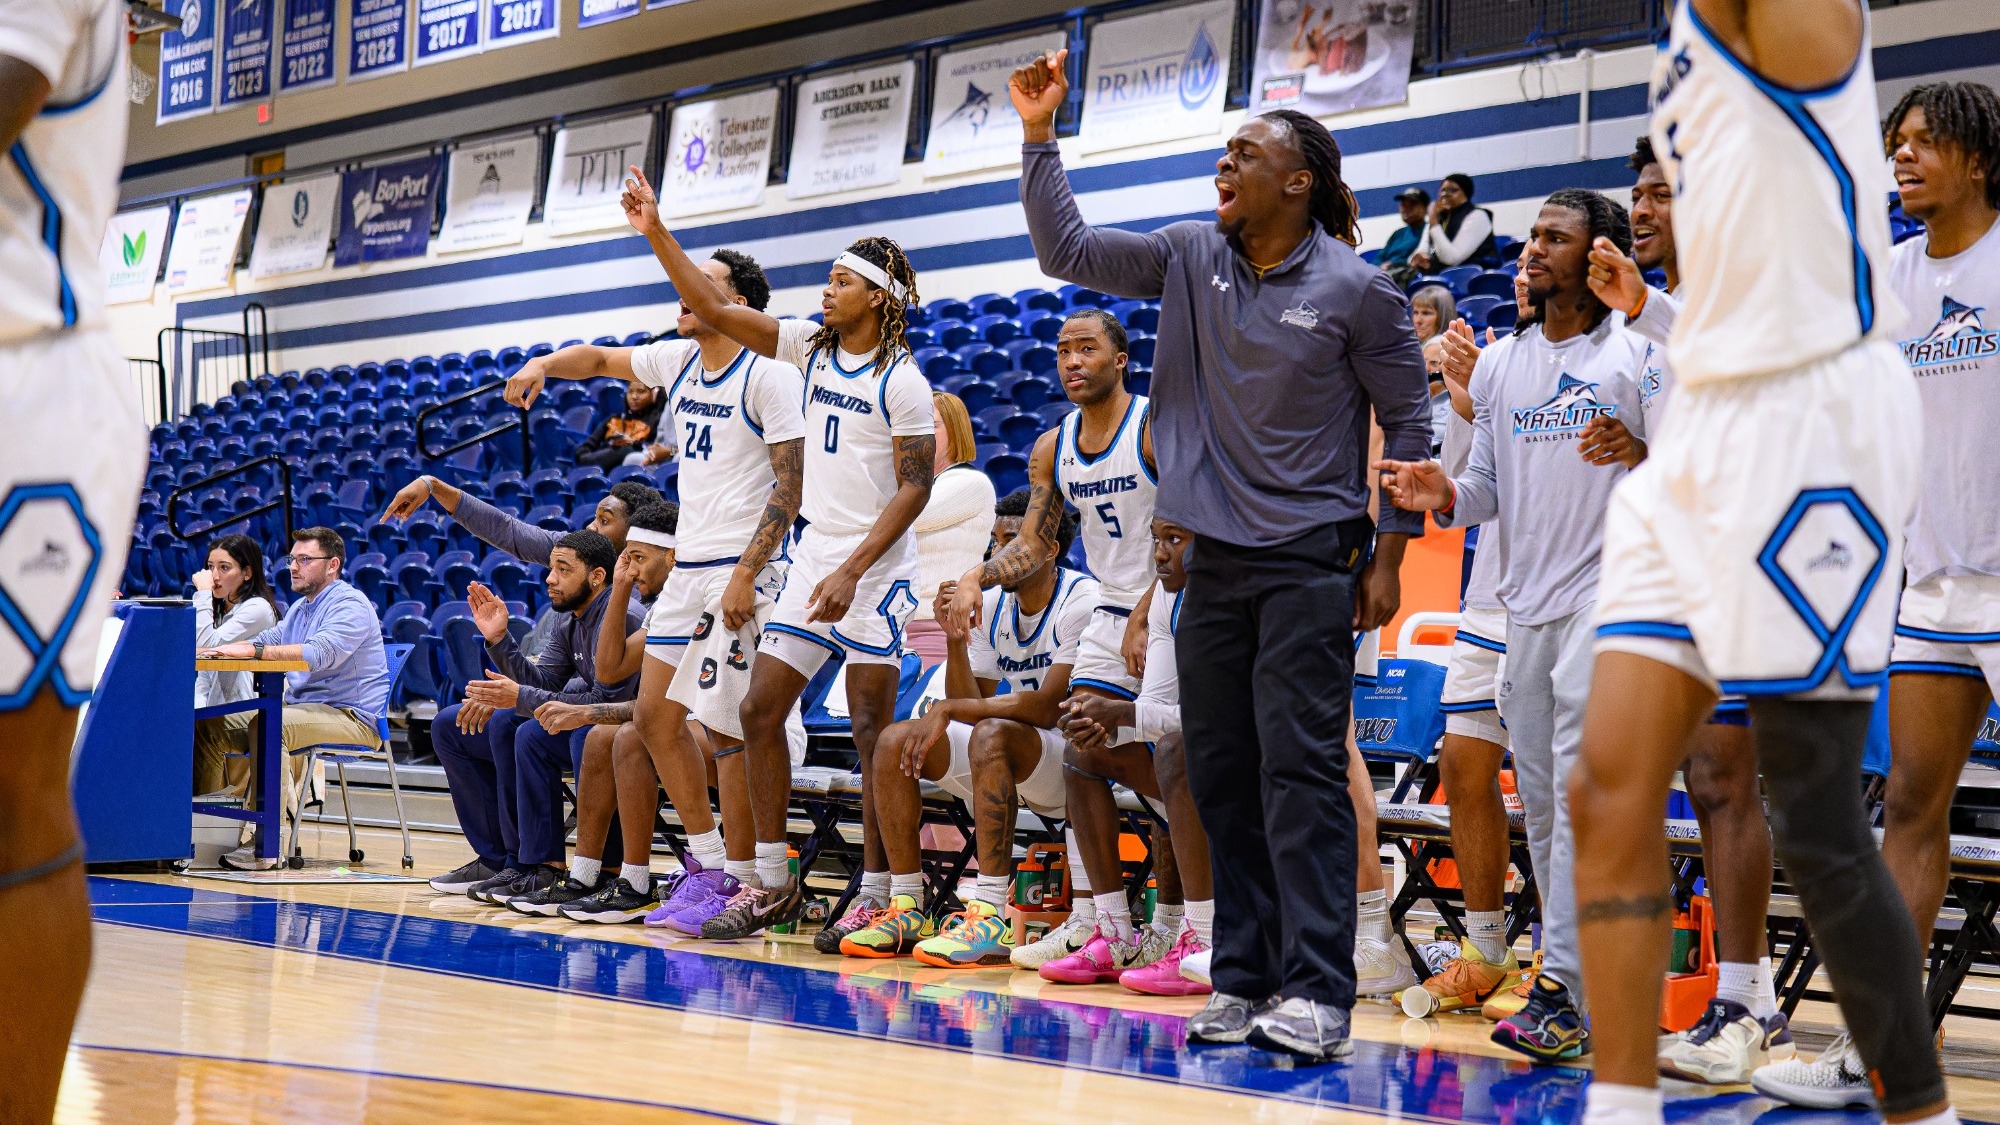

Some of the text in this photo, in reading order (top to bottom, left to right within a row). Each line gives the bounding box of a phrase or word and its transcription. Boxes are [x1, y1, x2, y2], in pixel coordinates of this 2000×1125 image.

[501, 1, 542, 32] 2017
[428, 17, 467, 51] 2017
[358, 36, 396, 68] 2022
[288, 53, 325, 83] 2022
[228, 70, 263, 99] 2023
[812, 76, 901, 104] ABERDEEN BARN
[820, 96, 890, 121] STEAKHOUSE
[719, 115, 770, 137] Tidewater
[717, 138, 767, 158] Collegiate
[715, 160, 761, 178] Academy
[376, 174, 428, 203] BayPort
[1903, 333, 1998, 366] MARLINS
[675, 396, 735, 419] MARLINS
[809, 384, 873, 415] MARLINS
[685, 422, 713, 461] 24
[824, 414, 839, 454] 0
[1525, 433, 1580, 444] BASKETBA
[1067, 474, 1138, 500] MARLINS
[1095, 502, 1123, 539] 5
[997, 652, 1053, 672] MARLINS
[1386, 669, 1406, 678] NCAA
[1382, 808, 1423, 820] MARLINS
[1952, 845, 2000, 860] MARLIN
